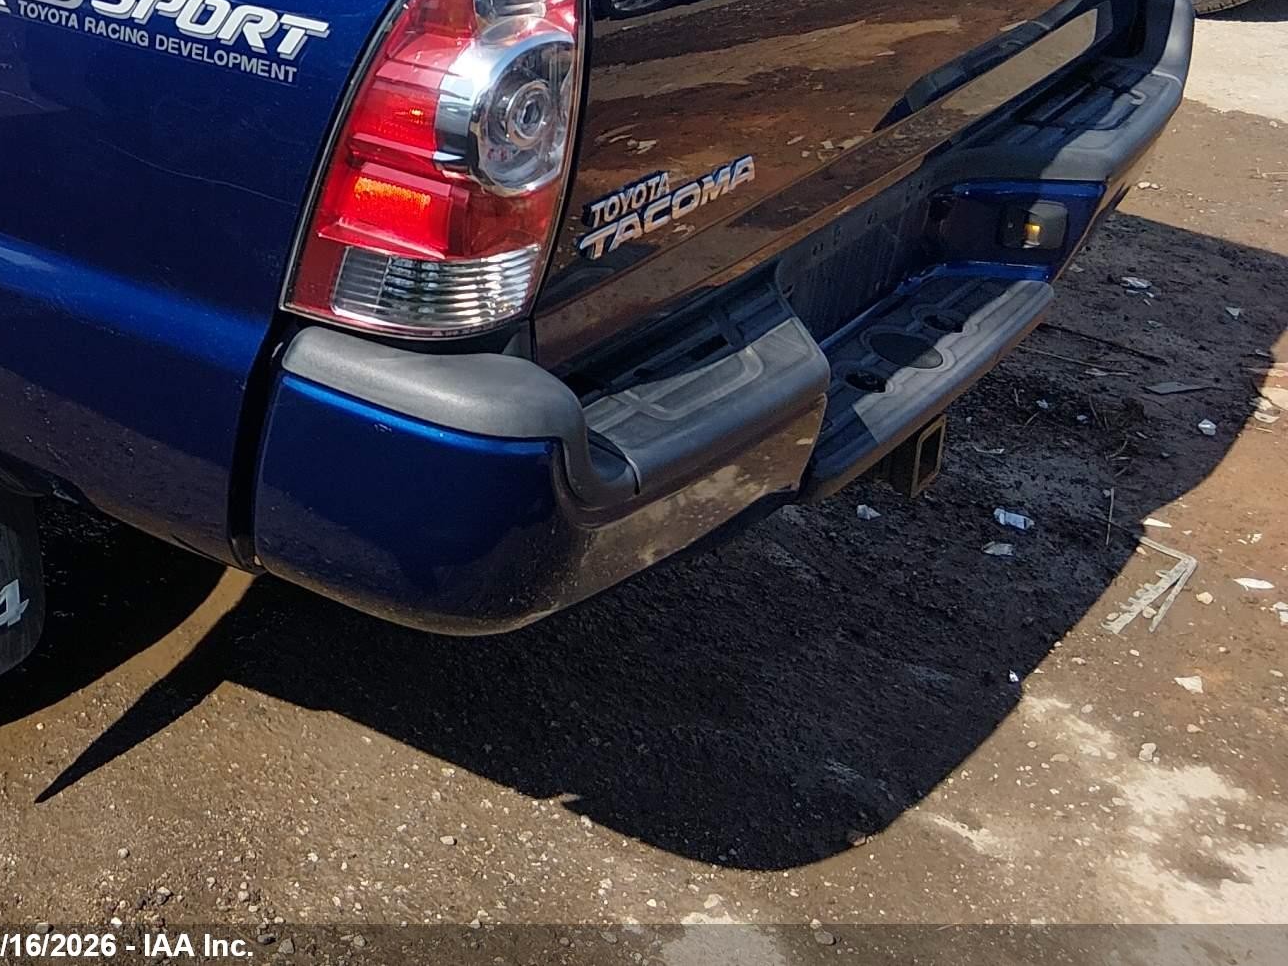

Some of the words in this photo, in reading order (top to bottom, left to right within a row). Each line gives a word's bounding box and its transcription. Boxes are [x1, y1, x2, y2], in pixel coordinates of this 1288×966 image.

[17, 0, 79, 31] TOYOTA
[84, 16, 150, 47] RACING
[154, 34, 299, 85] DEVELOPMENT
[578, 154, 756, 260] TACOMA
[588, 171, 671, 228] TOYOTA
